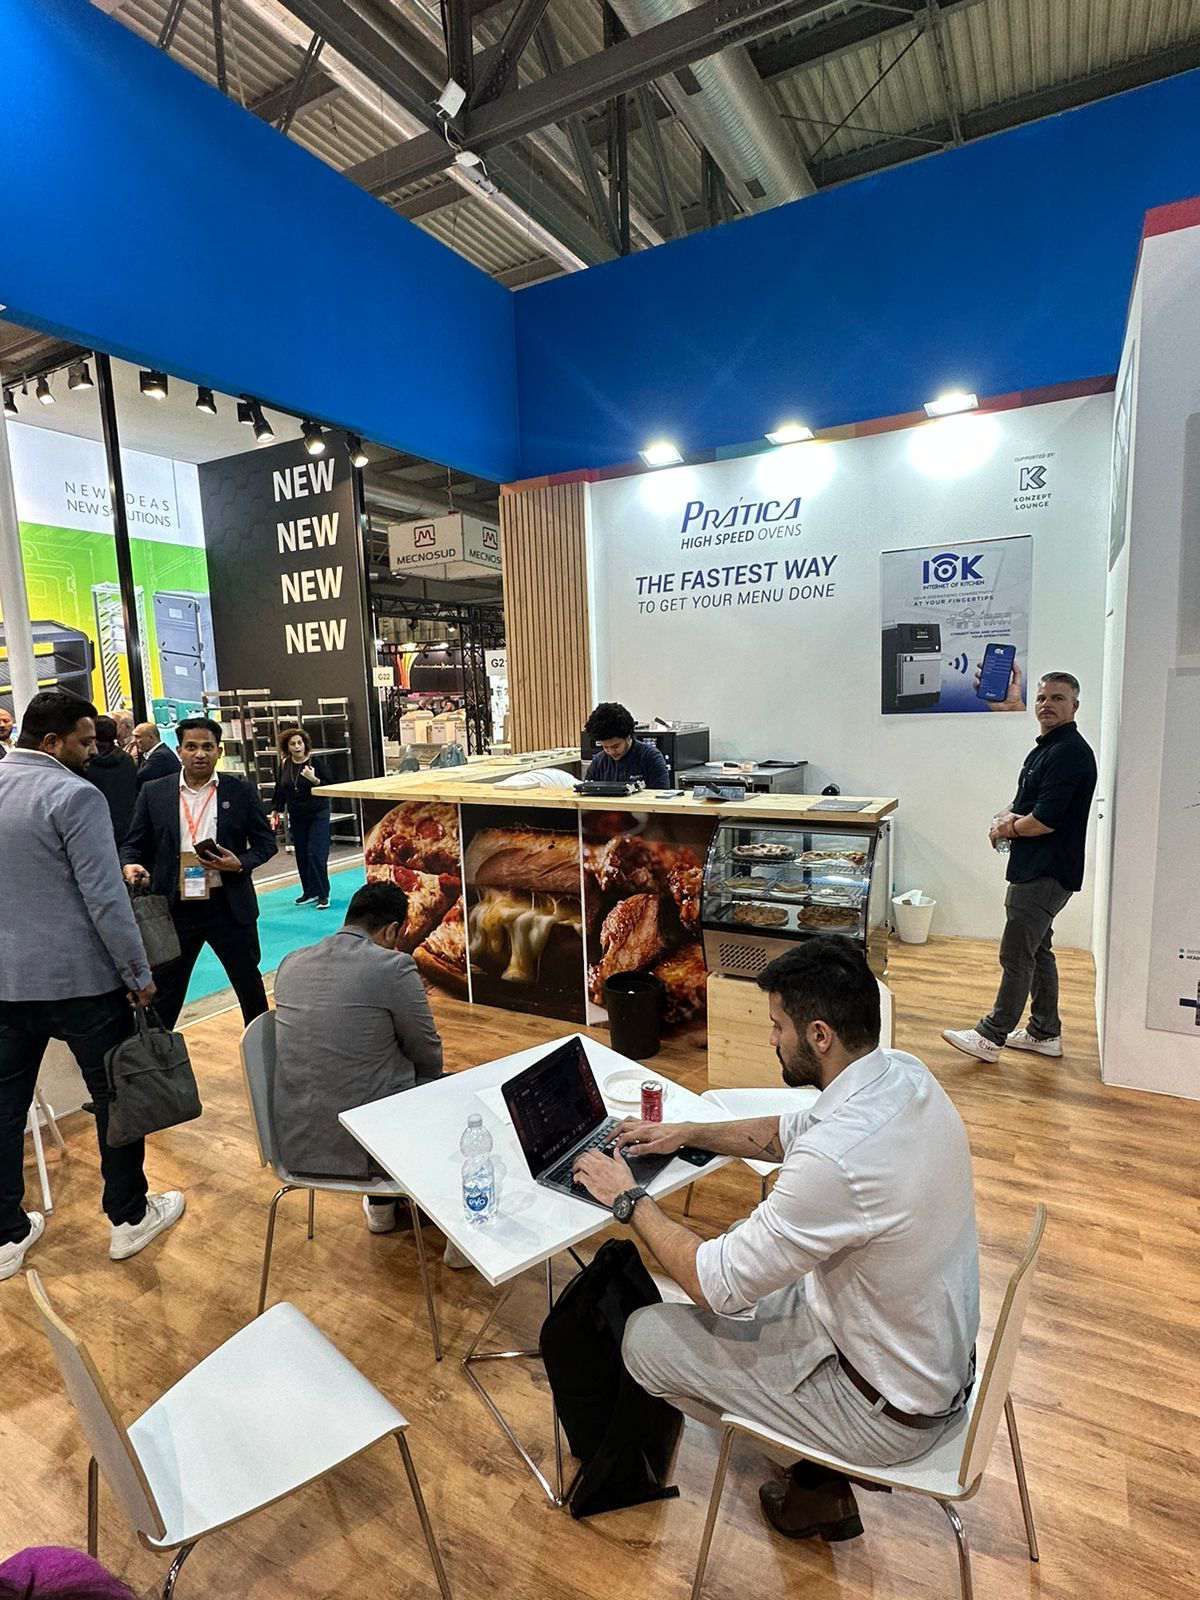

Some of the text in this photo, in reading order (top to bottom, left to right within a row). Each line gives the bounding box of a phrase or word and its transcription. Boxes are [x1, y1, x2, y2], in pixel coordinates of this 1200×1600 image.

[273, 457, 335, 503] NEW
[64, 480, 170, 511] NEW DEAS
[1013, 493, 1052, 503] KONZEPT
[1015, 501, 1049, 511] LOUNGE
[67, 499, 171, 528] NEW SUTIONS
[276, 512, 340, 554] NEW
[680, 523, 802, 550] HIGH SPEED OVENS
[396, 548, 456, 566] MECNOSUD
[469, 549, 502, 564] MECNOS
[281, 566, 343, 605] NEW
[635, 554, 838, 595] THE FASTEST WAY
[638, 583, 836, 614] TO GET YOUR MENU DONE
[948, 595, 994, 604] FINGERTIPS
[285, 618, 347, 655] NEW
[490, 658, 506, 669] G2
